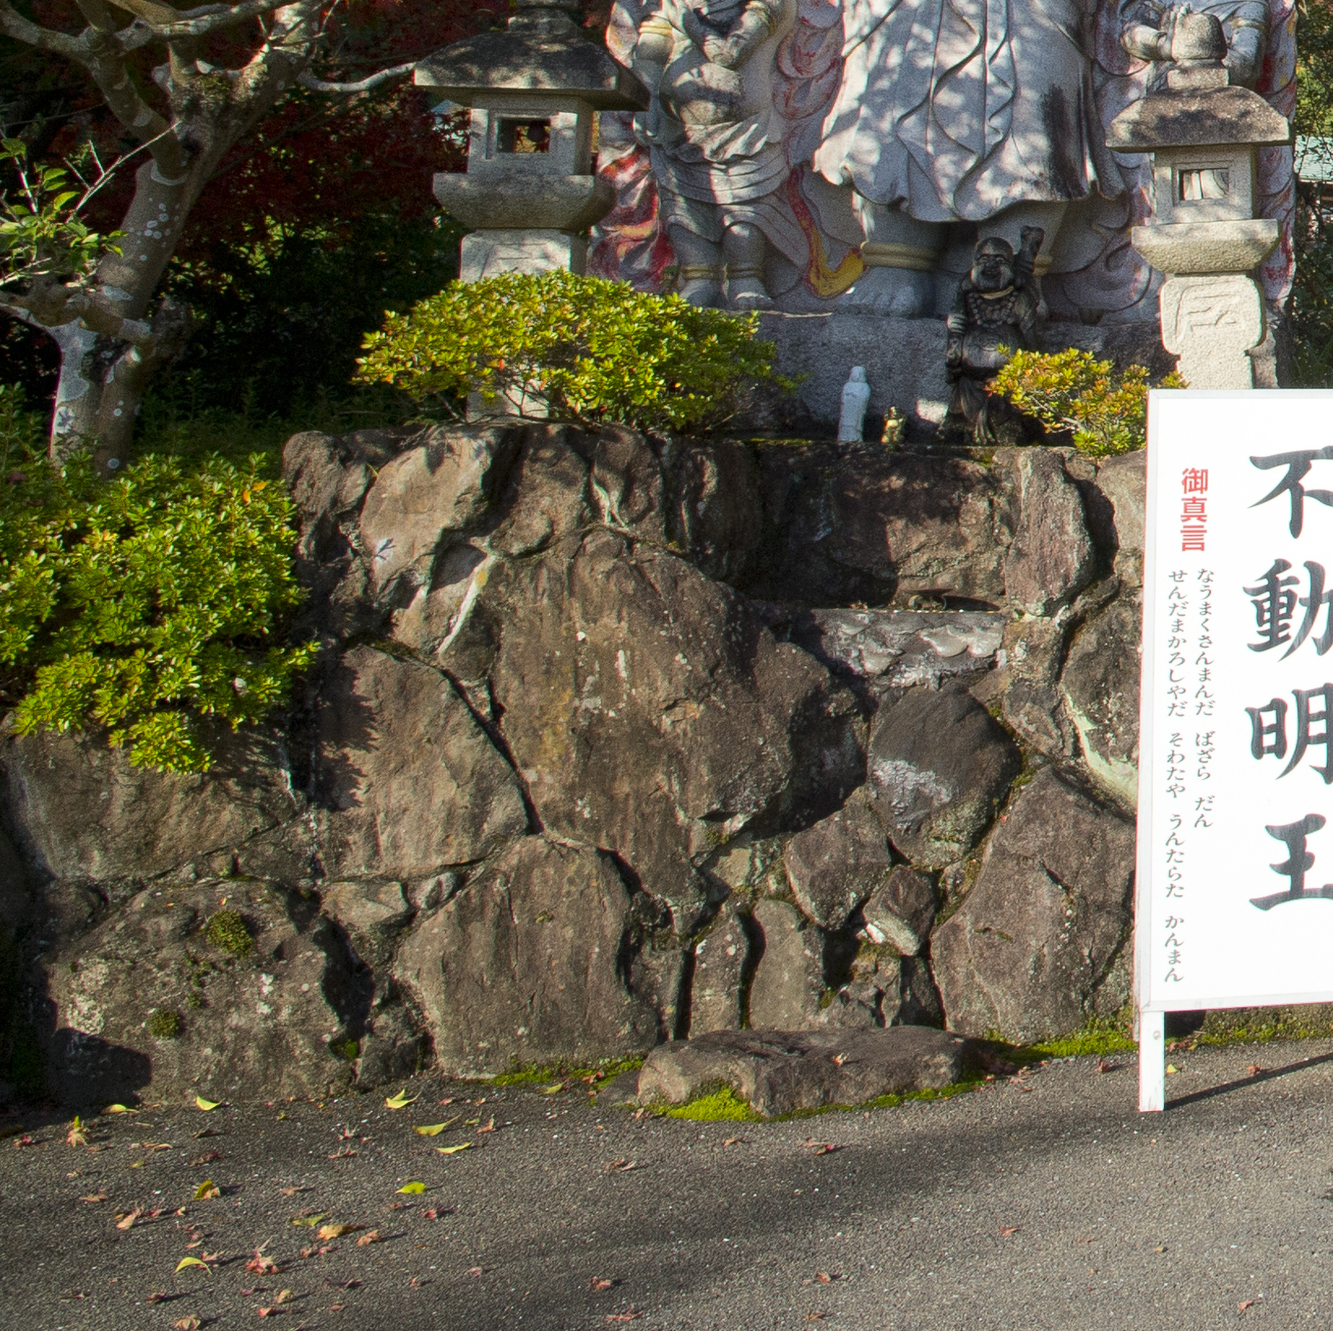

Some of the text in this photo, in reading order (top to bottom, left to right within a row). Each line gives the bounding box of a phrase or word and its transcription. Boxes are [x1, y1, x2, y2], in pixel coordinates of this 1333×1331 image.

[1180, 467, 1209, 552] 御真言
[1164, 569, 1189, 983] せんだまかろしやだ そわたや うんたらた かんまん
[1193, 568, 1216, 828] なうまくさんまんだ ばざら だん
